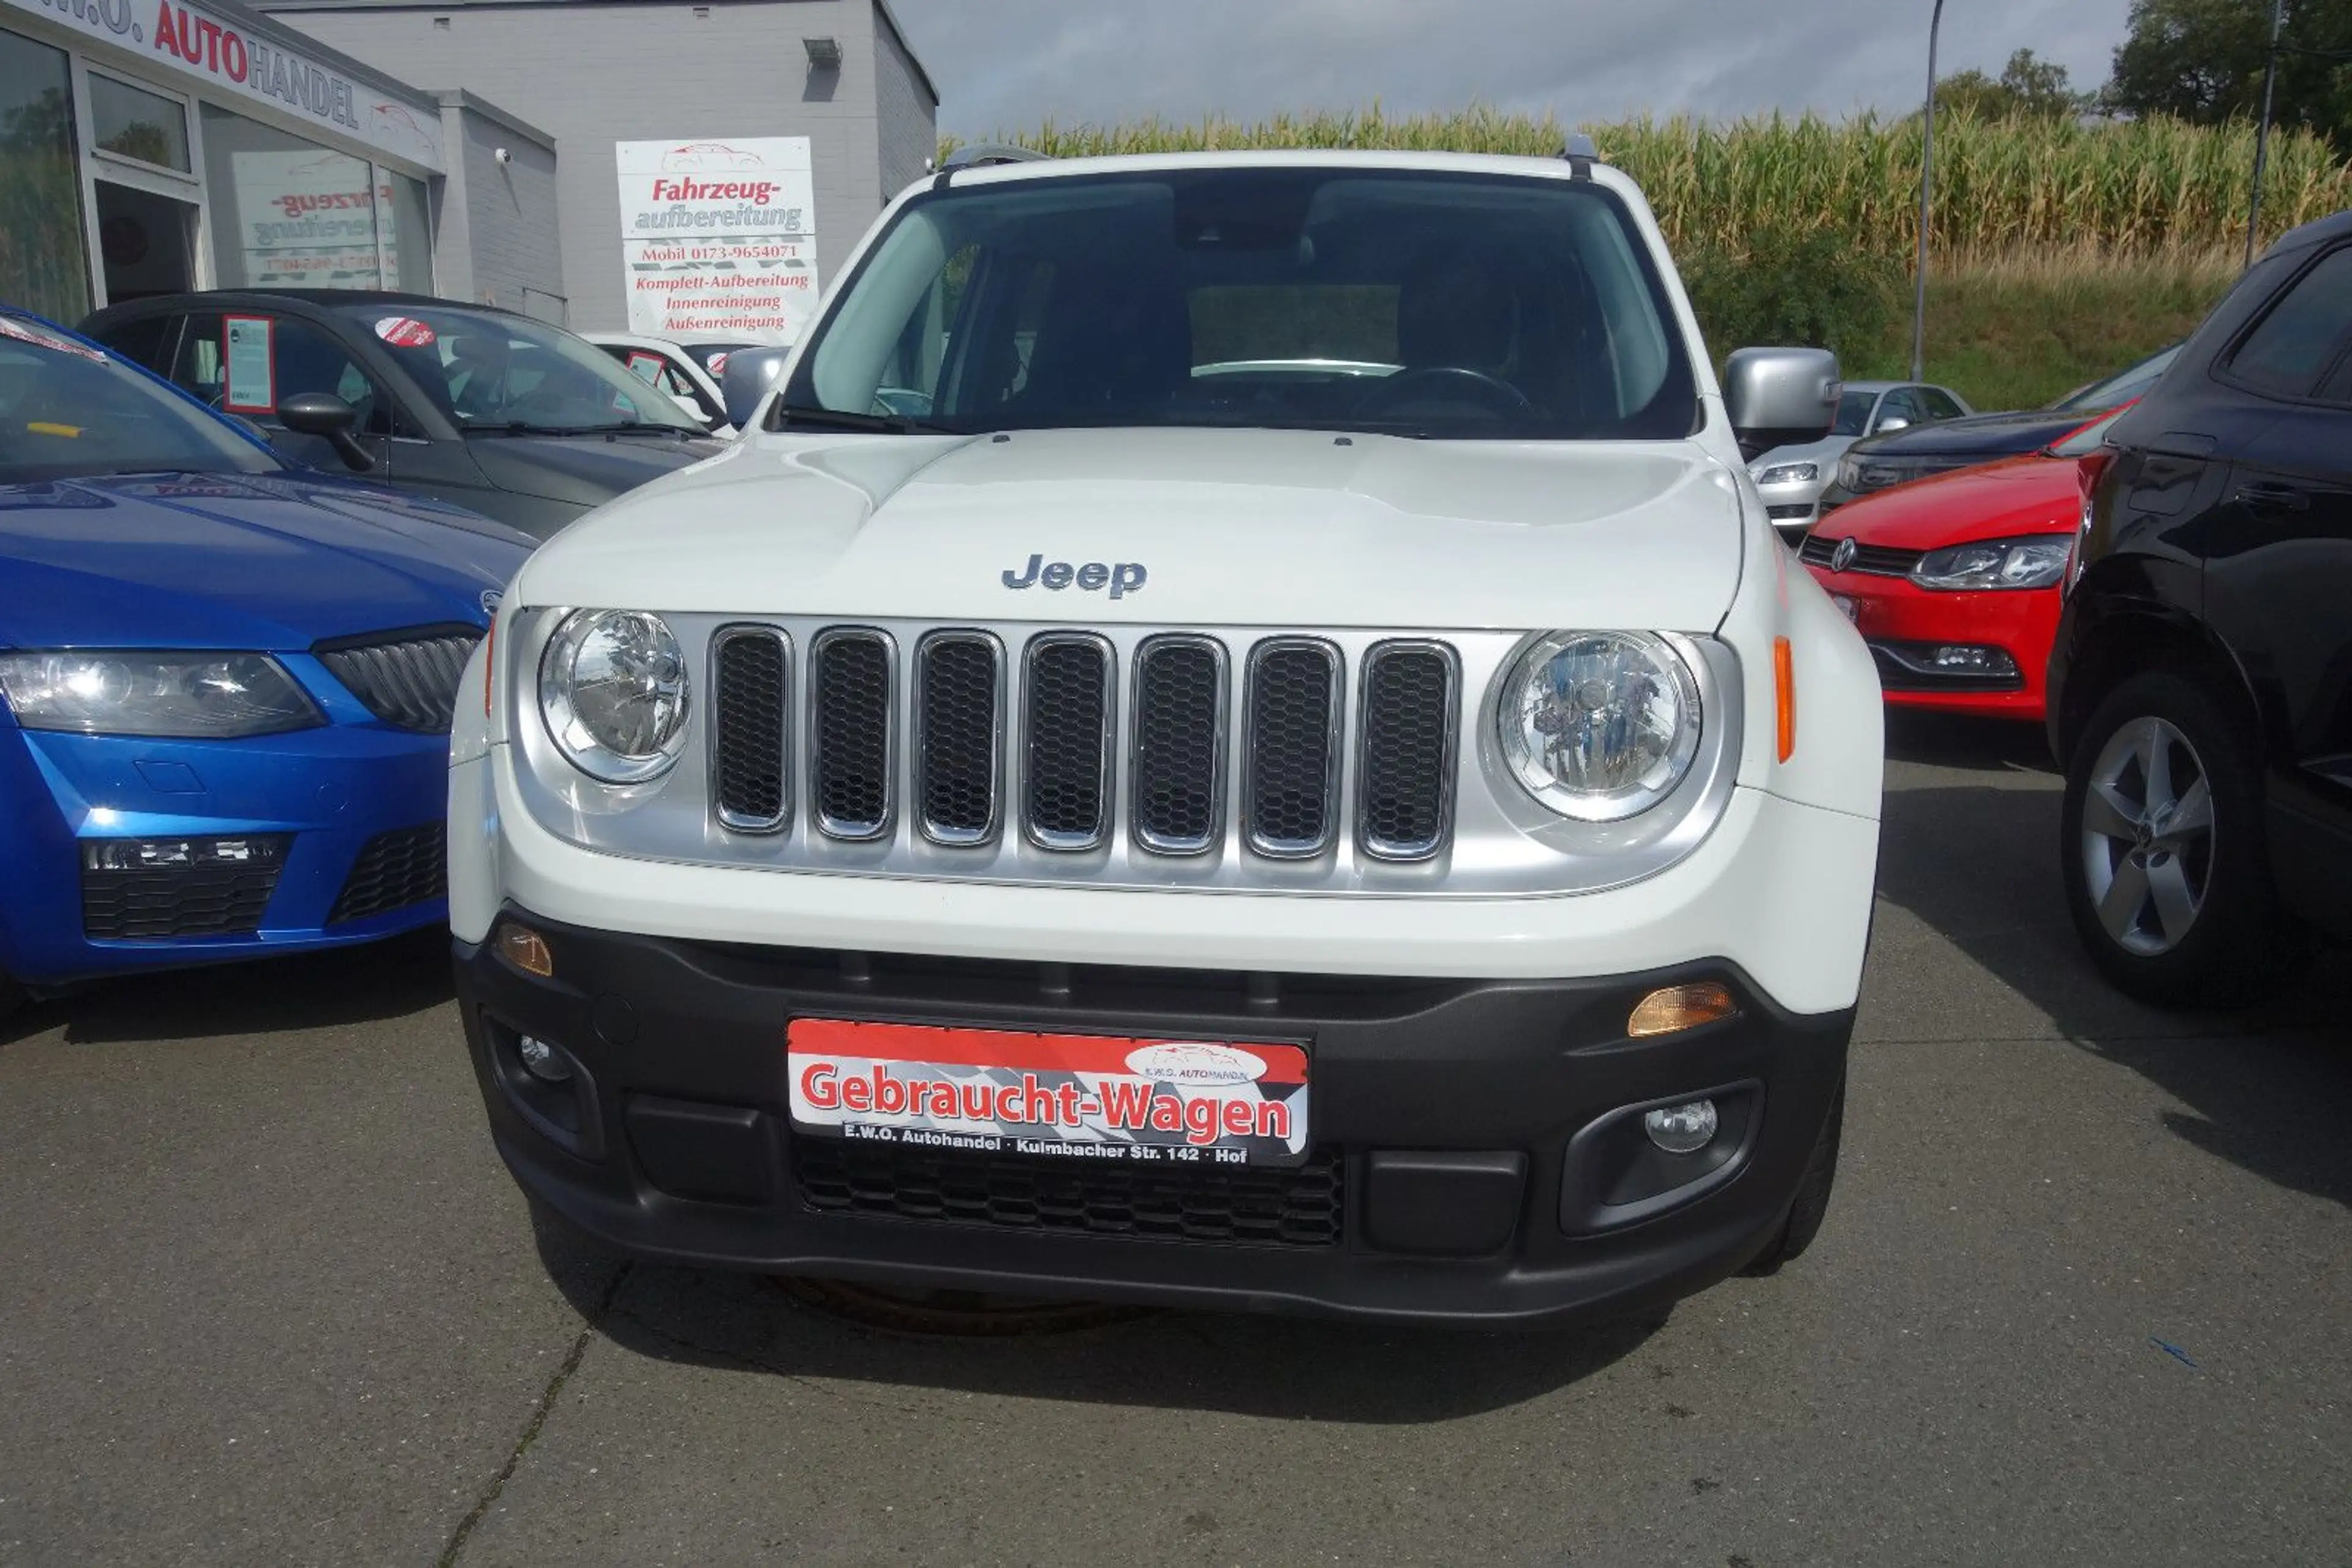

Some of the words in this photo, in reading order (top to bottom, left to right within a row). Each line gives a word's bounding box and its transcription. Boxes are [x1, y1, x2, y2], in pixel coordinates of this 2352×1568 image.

[154, 0, 359, 130] AUTOHANDEL
[652, 176, 782, 205] Fahrzeug-
[635, 203, 802, 232] aufbereitung
[642, 247, 685, 262] Mobil
[636, 273, 809, 293] Komplett-Aufbereitung
[666, 295, 781, 311] Innenreinigung
[665, 315, 785, 331] Außenreinigung
[1001, 554, 1148, 600] Jeep
[799, 1062, 1291, 1145] Gebraucht-Wagen
[844, 1124, 897, 1142] E.W.O.
[902, 1130, 1001, 1151] Autohandel
[1016, 1140, 1125, 1158] Kulmbacher
[1130, 1147, 1161, 1159] Str.
[1167, 1148, 1199, 1161] 142
[1215, 1149, 1248, 1163] Hof
